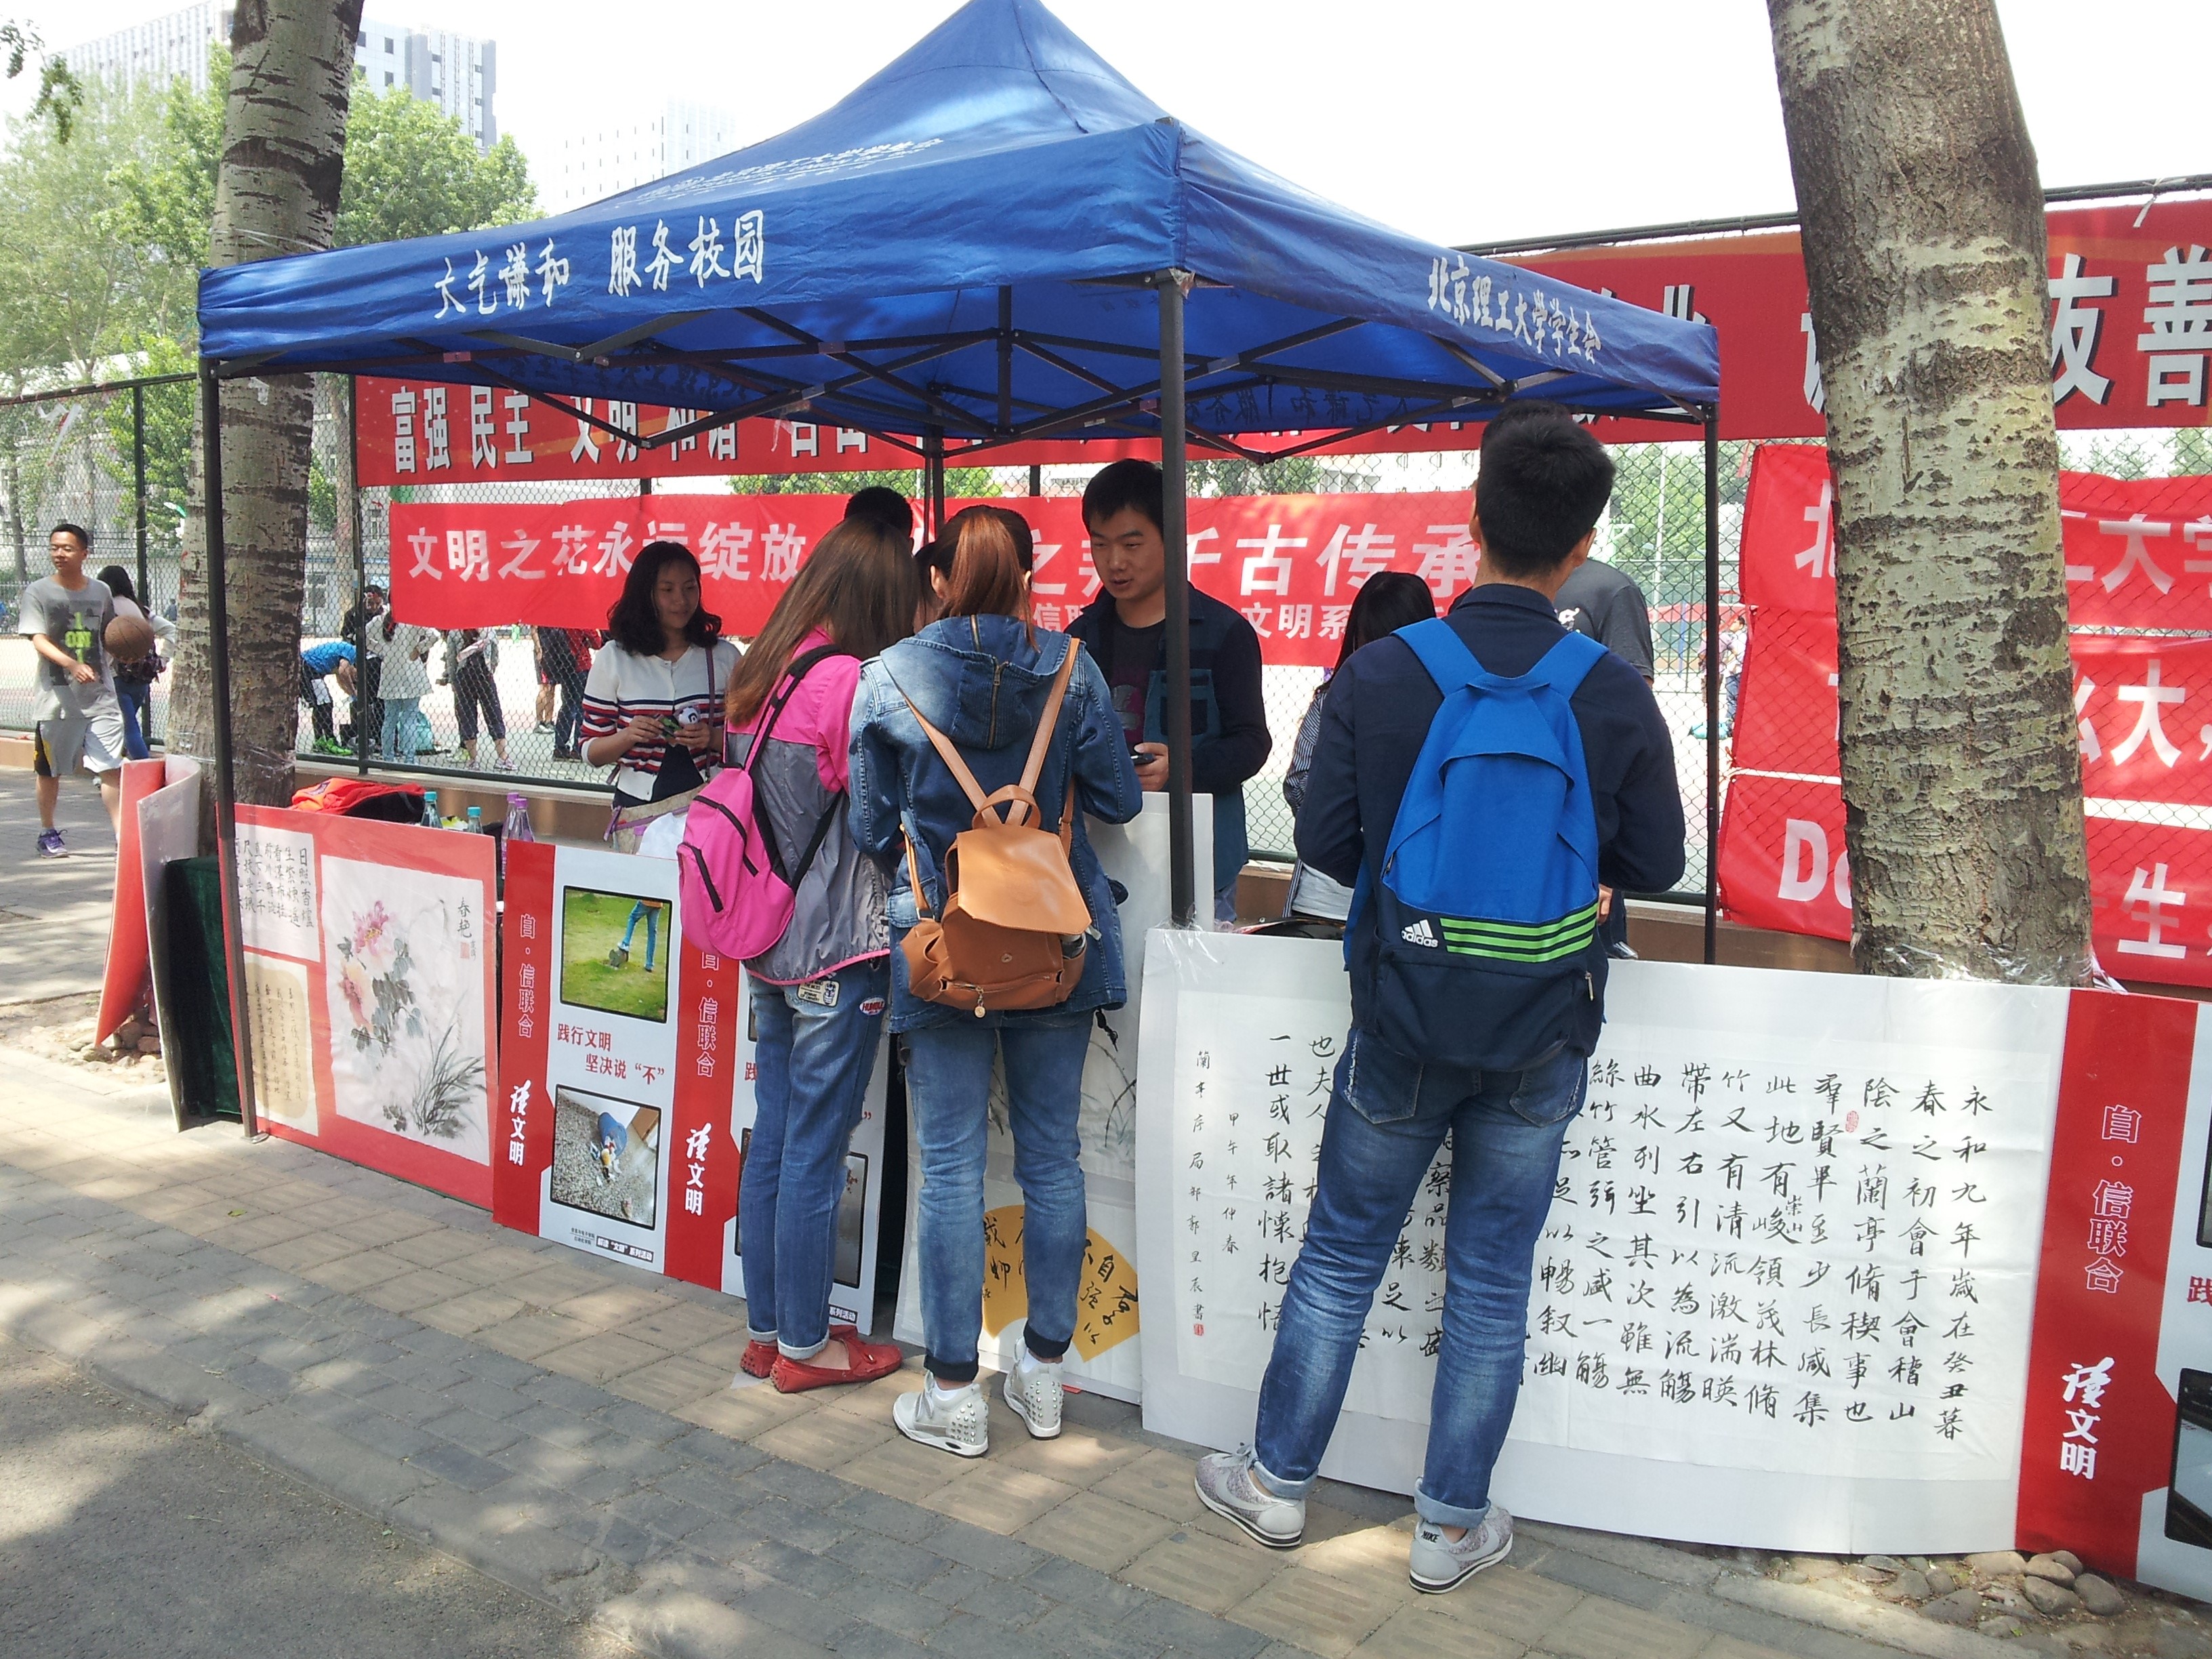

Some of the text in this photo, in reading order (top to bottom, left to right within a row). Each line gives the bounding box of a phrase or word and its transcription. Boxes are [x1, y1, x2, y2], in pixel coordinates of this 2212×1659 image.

[609, 209, 764, 297] 服务校园
[1428, 255, 1601, 365] 北京理工大学学生会
[392, 386, 450, 473] 富强
[471, 385, 533, 469] 民主
[570, 395, 638, 464] 文明
[1401, 929, 1439, 948] adidas
[557, 1023, 612, 1052] 践行文明
[1421, 1530, 1440, 1544] NIKE
